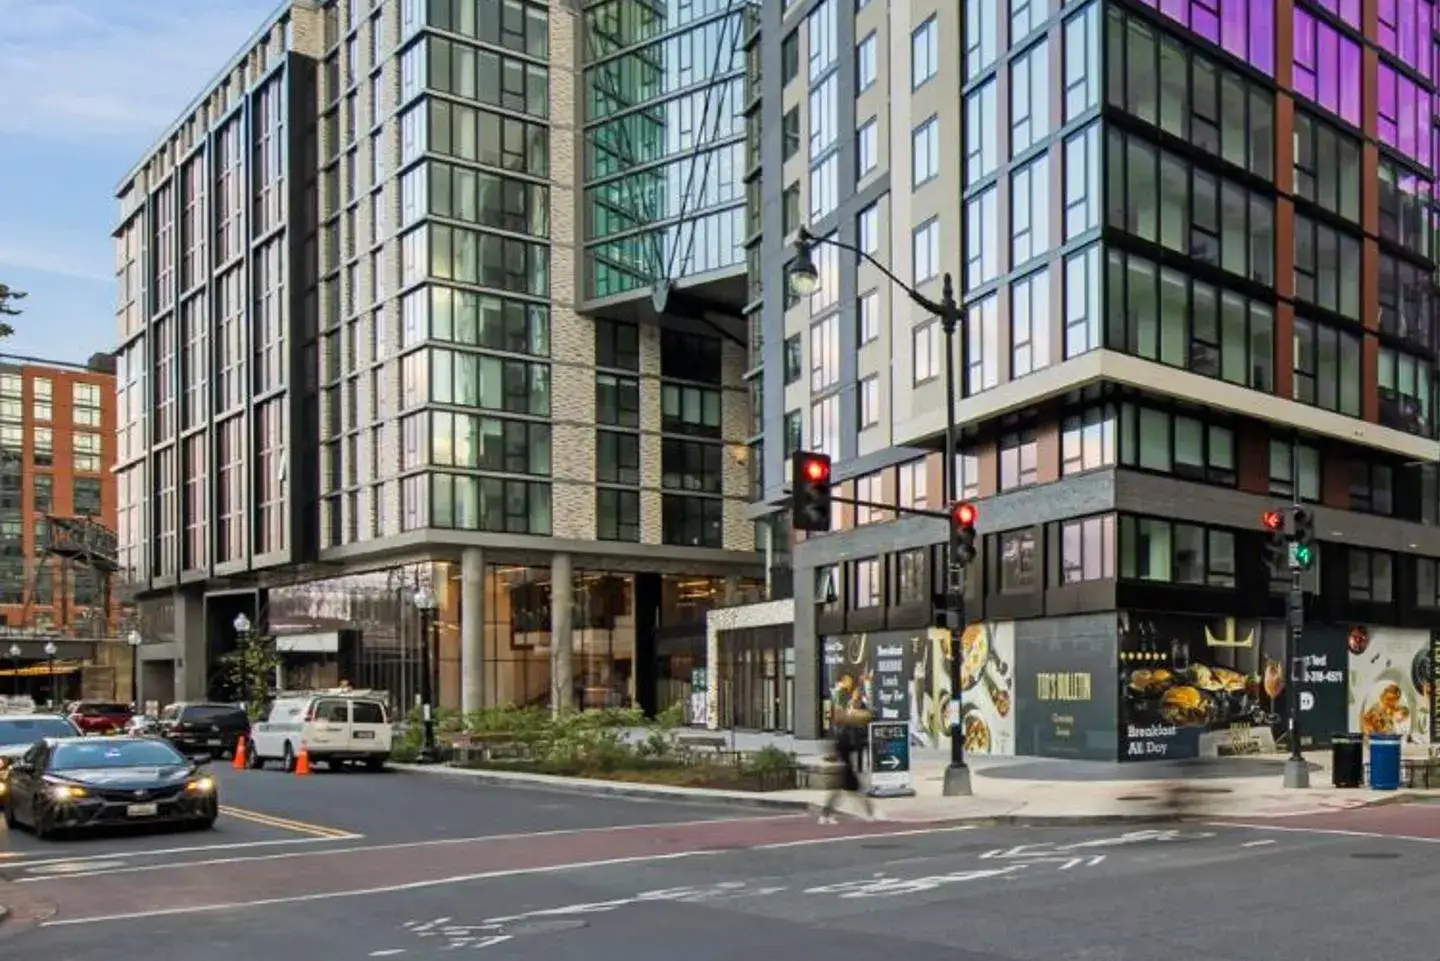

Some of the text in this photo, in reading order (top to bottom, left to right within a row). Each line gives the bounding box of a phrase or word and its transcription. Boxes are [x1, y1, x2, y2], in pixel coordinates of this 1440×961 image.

[1128, 723, 1176, 738] Breakfast
[1128, 741, 1168, 755] All Day
